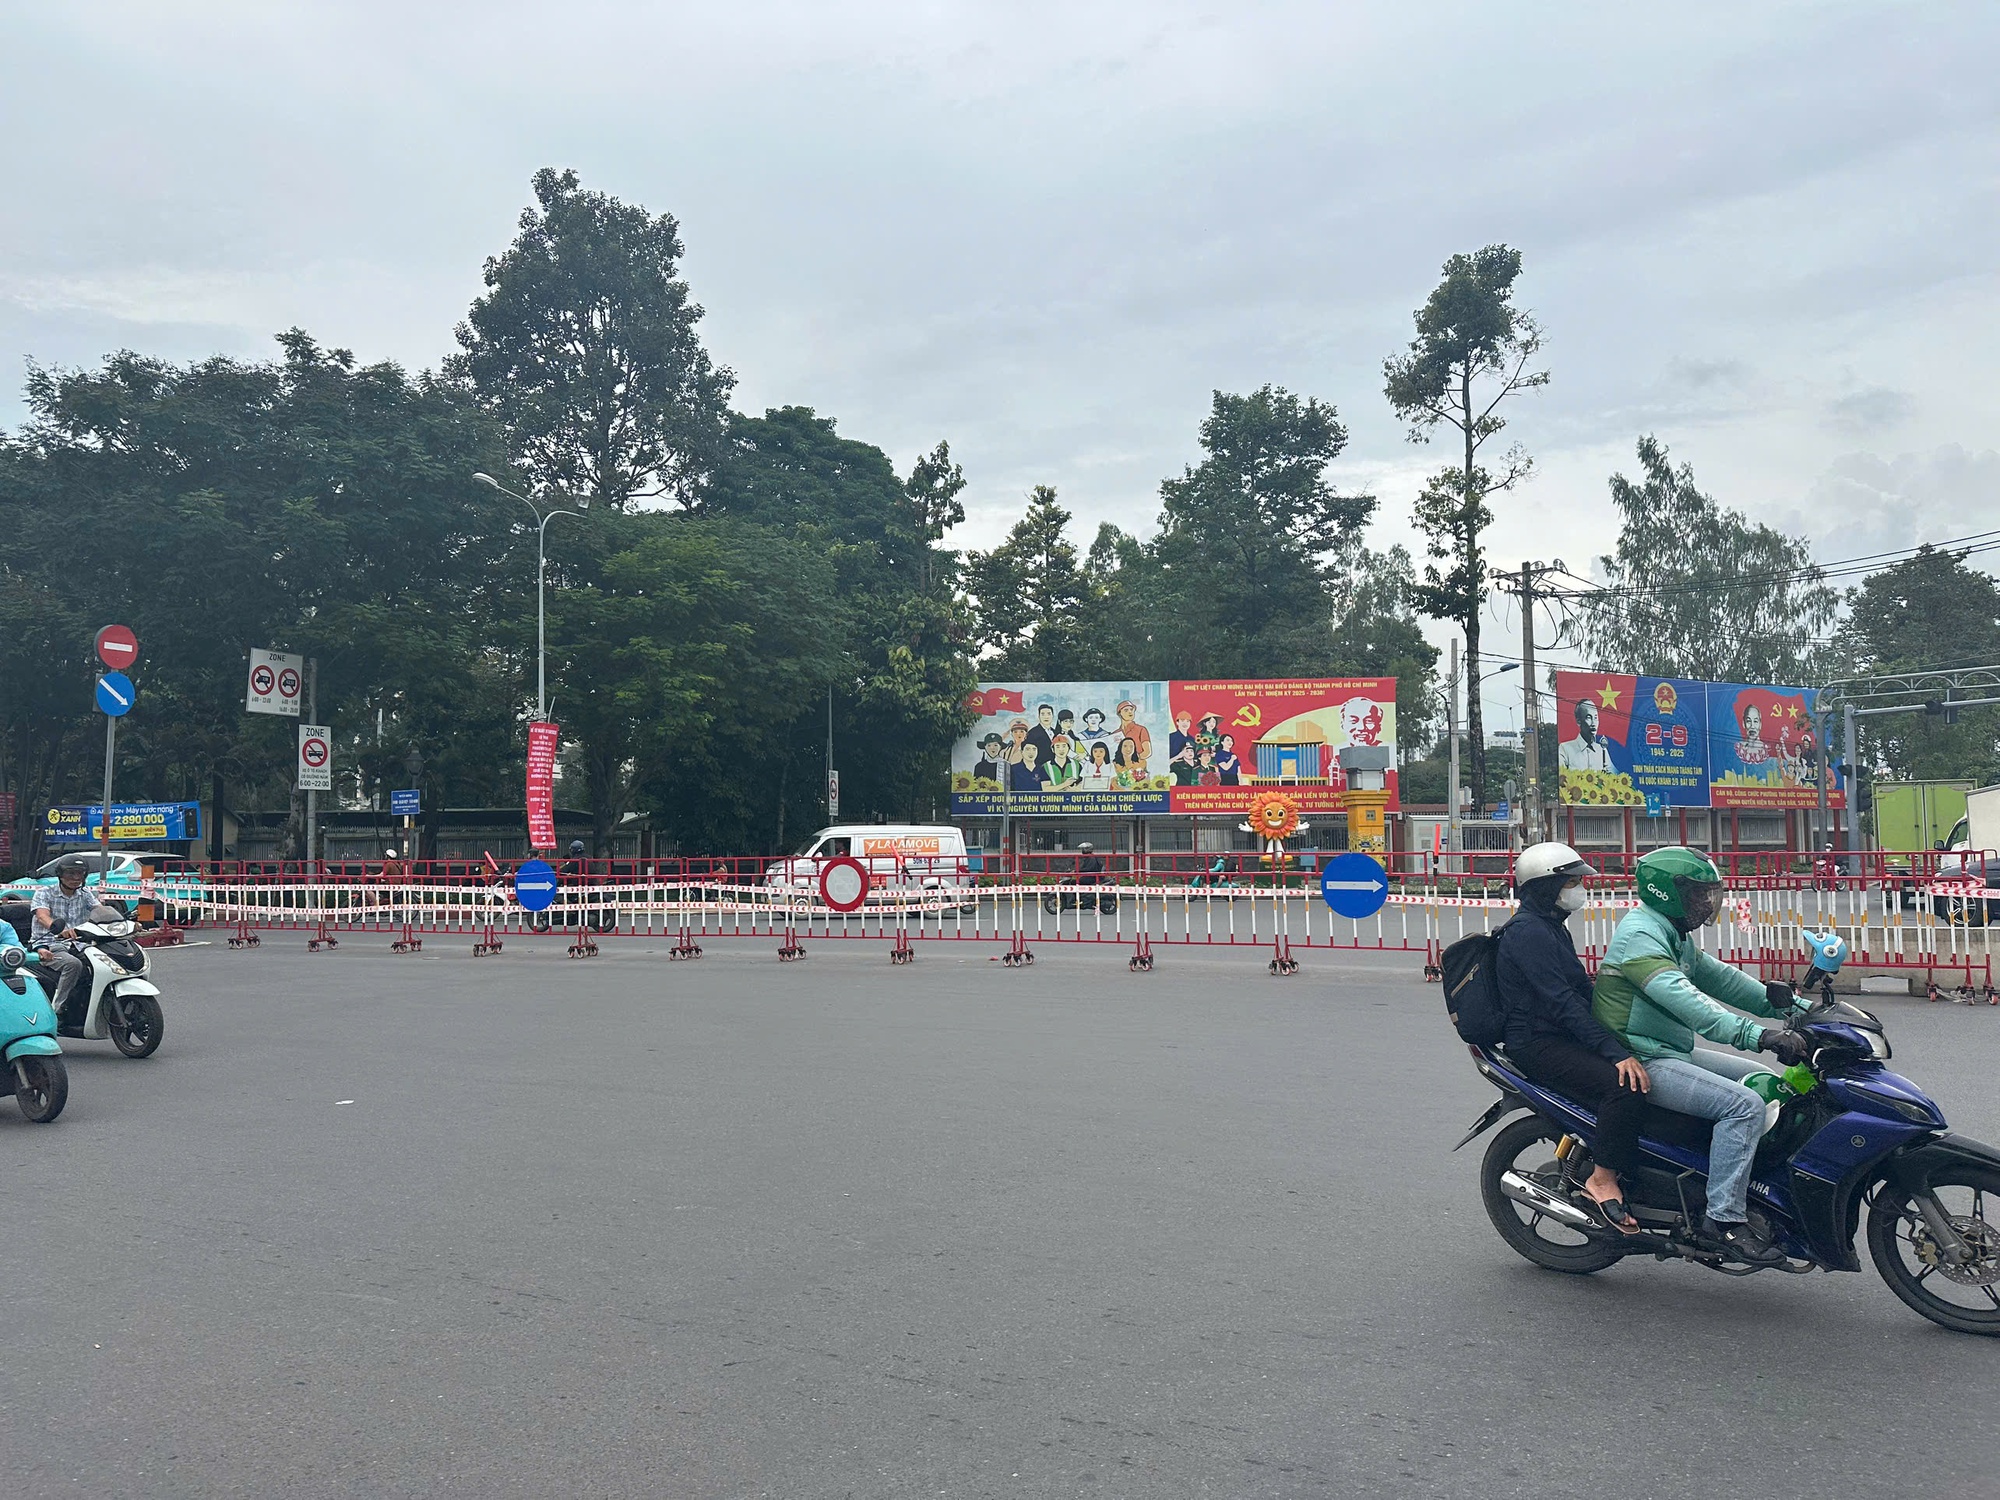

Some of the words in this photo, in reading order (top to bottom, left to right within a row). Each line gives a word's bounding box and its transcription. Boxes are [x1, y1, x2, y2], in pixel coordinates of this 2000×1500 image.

[269, 653, 286, 662] ZONE
[306, 728, 324, 737] ZONE
[1645, 723, 1688, 746] 2-9
[1651, 748, 1665, 756] 1945
[1670, 748, 1684, 757] 2025
[958, 794, 973, 803] SẮP
[975, 794, 990, 803] XẾP
[1018, 794, 1039, 803] HÀNH
[1041, 794, 1064, 802] CHÍNH
[1072, 793, 1094, 803] QUYẾT
[1096, 793, 1116, 802] SÁCH
[1119, 792, 1141, 802] CHIẾN
[1143, 794, 1162, 803] LƯỢC
[126, 806, 140, 815] Máy
[157, 805, 173, 814] nóng
[987, 804, 995, 812] VÌ
[1009, 804, 1038, 812] NGUYÊN
[1062, 804, 1082, 812] MÌNH
[1084, 803, 1099, 811] CỦA
[1101, 803, 1117, 811] DÂN
[1119, 803, 1134, 813] TỘC
[1647, 882, 1669, 902] Grab
